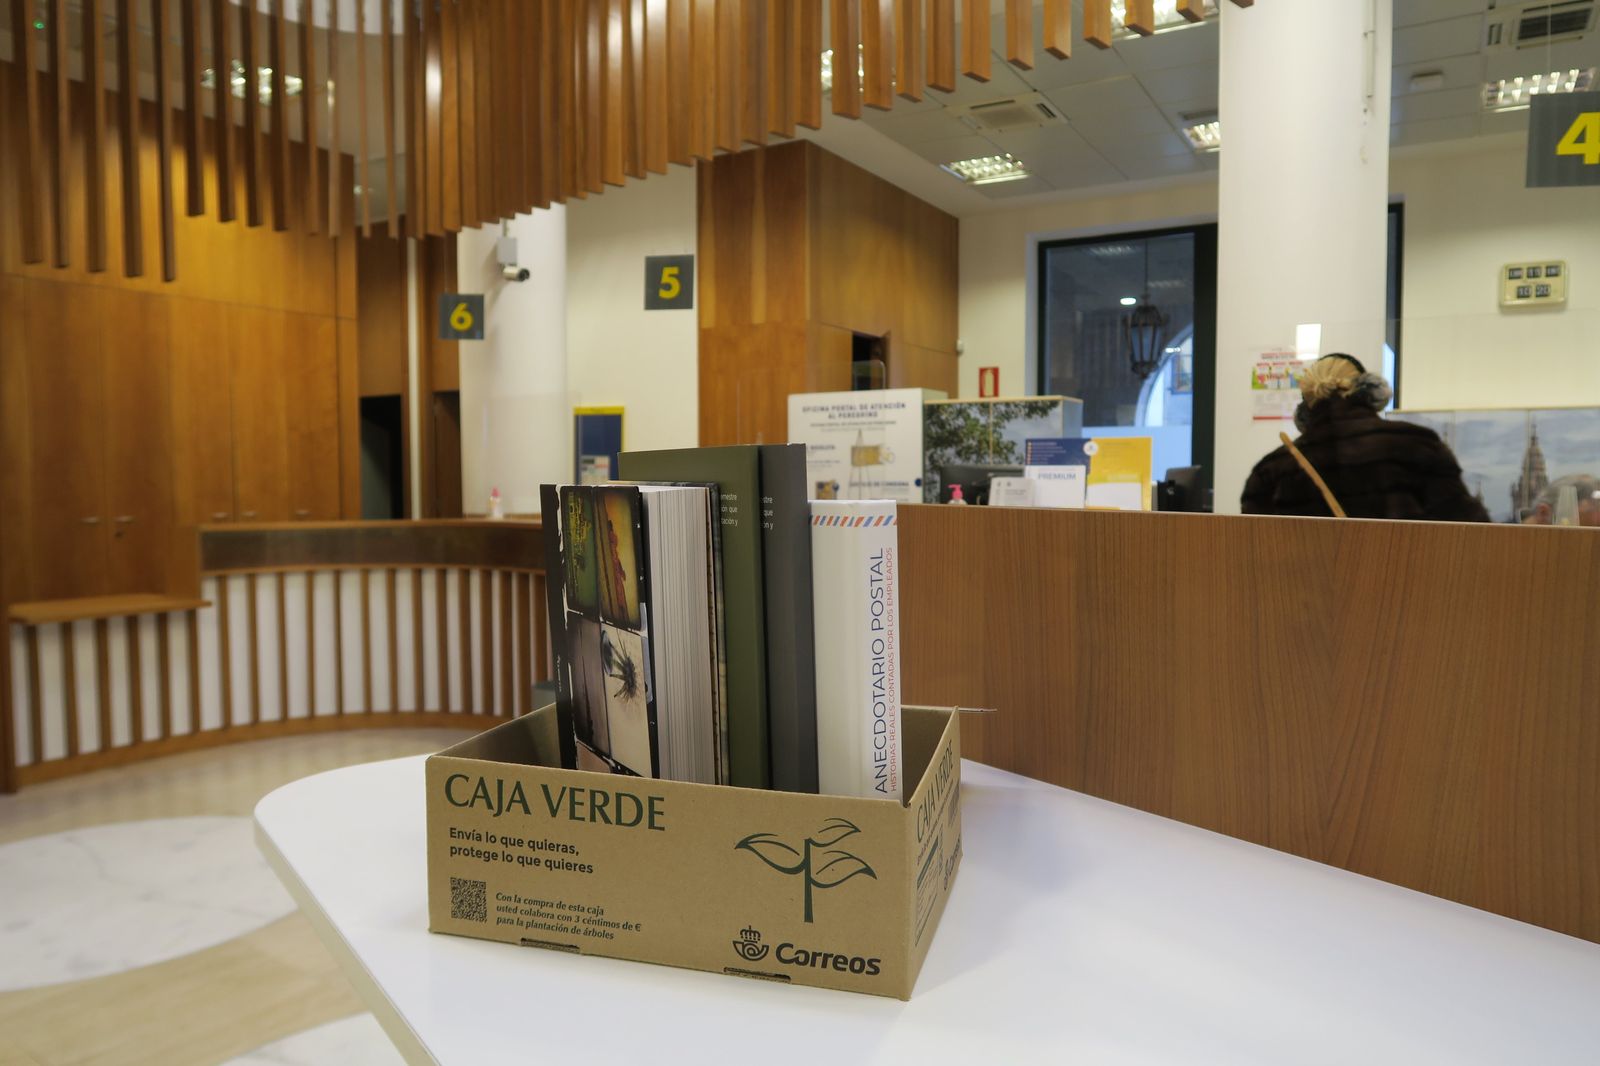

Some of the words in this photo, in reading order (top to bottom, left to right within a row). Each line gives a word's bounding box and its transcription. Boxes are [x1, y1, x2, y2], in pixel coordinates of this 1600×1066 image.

[1556, 111, 1600, 165] 4
[658, 266, 682, 299] 5
[450, 302, 474, 331] 6
[1038, 472, 1077, 481] PREMIUM
[728, 506, 738, 514] que
[870, 547, 884, 631] POSTAL
[886, 547, 894, 606] EMPLEADOS
[886, 608, 894, 627] LOS
[872, 638, 887, 794] ANECDOTARIO
[889, 742, 897, 792] HISTORIAS
[444, 773, 532, 818] CAJA
[540, 783, 665, 832] VERDE
[916, 784, 937, 844] CAJA
[449, 827, 482, 842] Envía
[485, 831, 497, 844] lo
[500, 835, 524, 848] que
[527, 838, 580, 856] quieras,
[450, 845, 499, 862] protege
[501, 851, 513, 863] lo
[517, 854, 541, 867] que
[544, 858, 594, 874] quieres
[496, 892, 512, 902] Con
[513, 894, 522, 903] la
[523, 898, 554, 909] compra
[556, 900, 567, 910] de
[568, 903, 585, 913] esta
[587, 905, 604, 918] caja
[496, 904, 518, 914] usted
[519, 908, 555, 920] colabora
[557, 914, 572, 922] con
[574, 915, 580, 923] 3
[582, 916, 621, 929] céntimos
[622, 921, 633, 931] de
[634, 923, 642, 932] €
[496, 916, 515, 926] para
[516, 917, 524, 927] la
[525, 919, 569, 934] plantación
[570, 925, 581, 935] de
[583, 927, 615, 940] árboles
[775, 942, 881, 976] Correos
